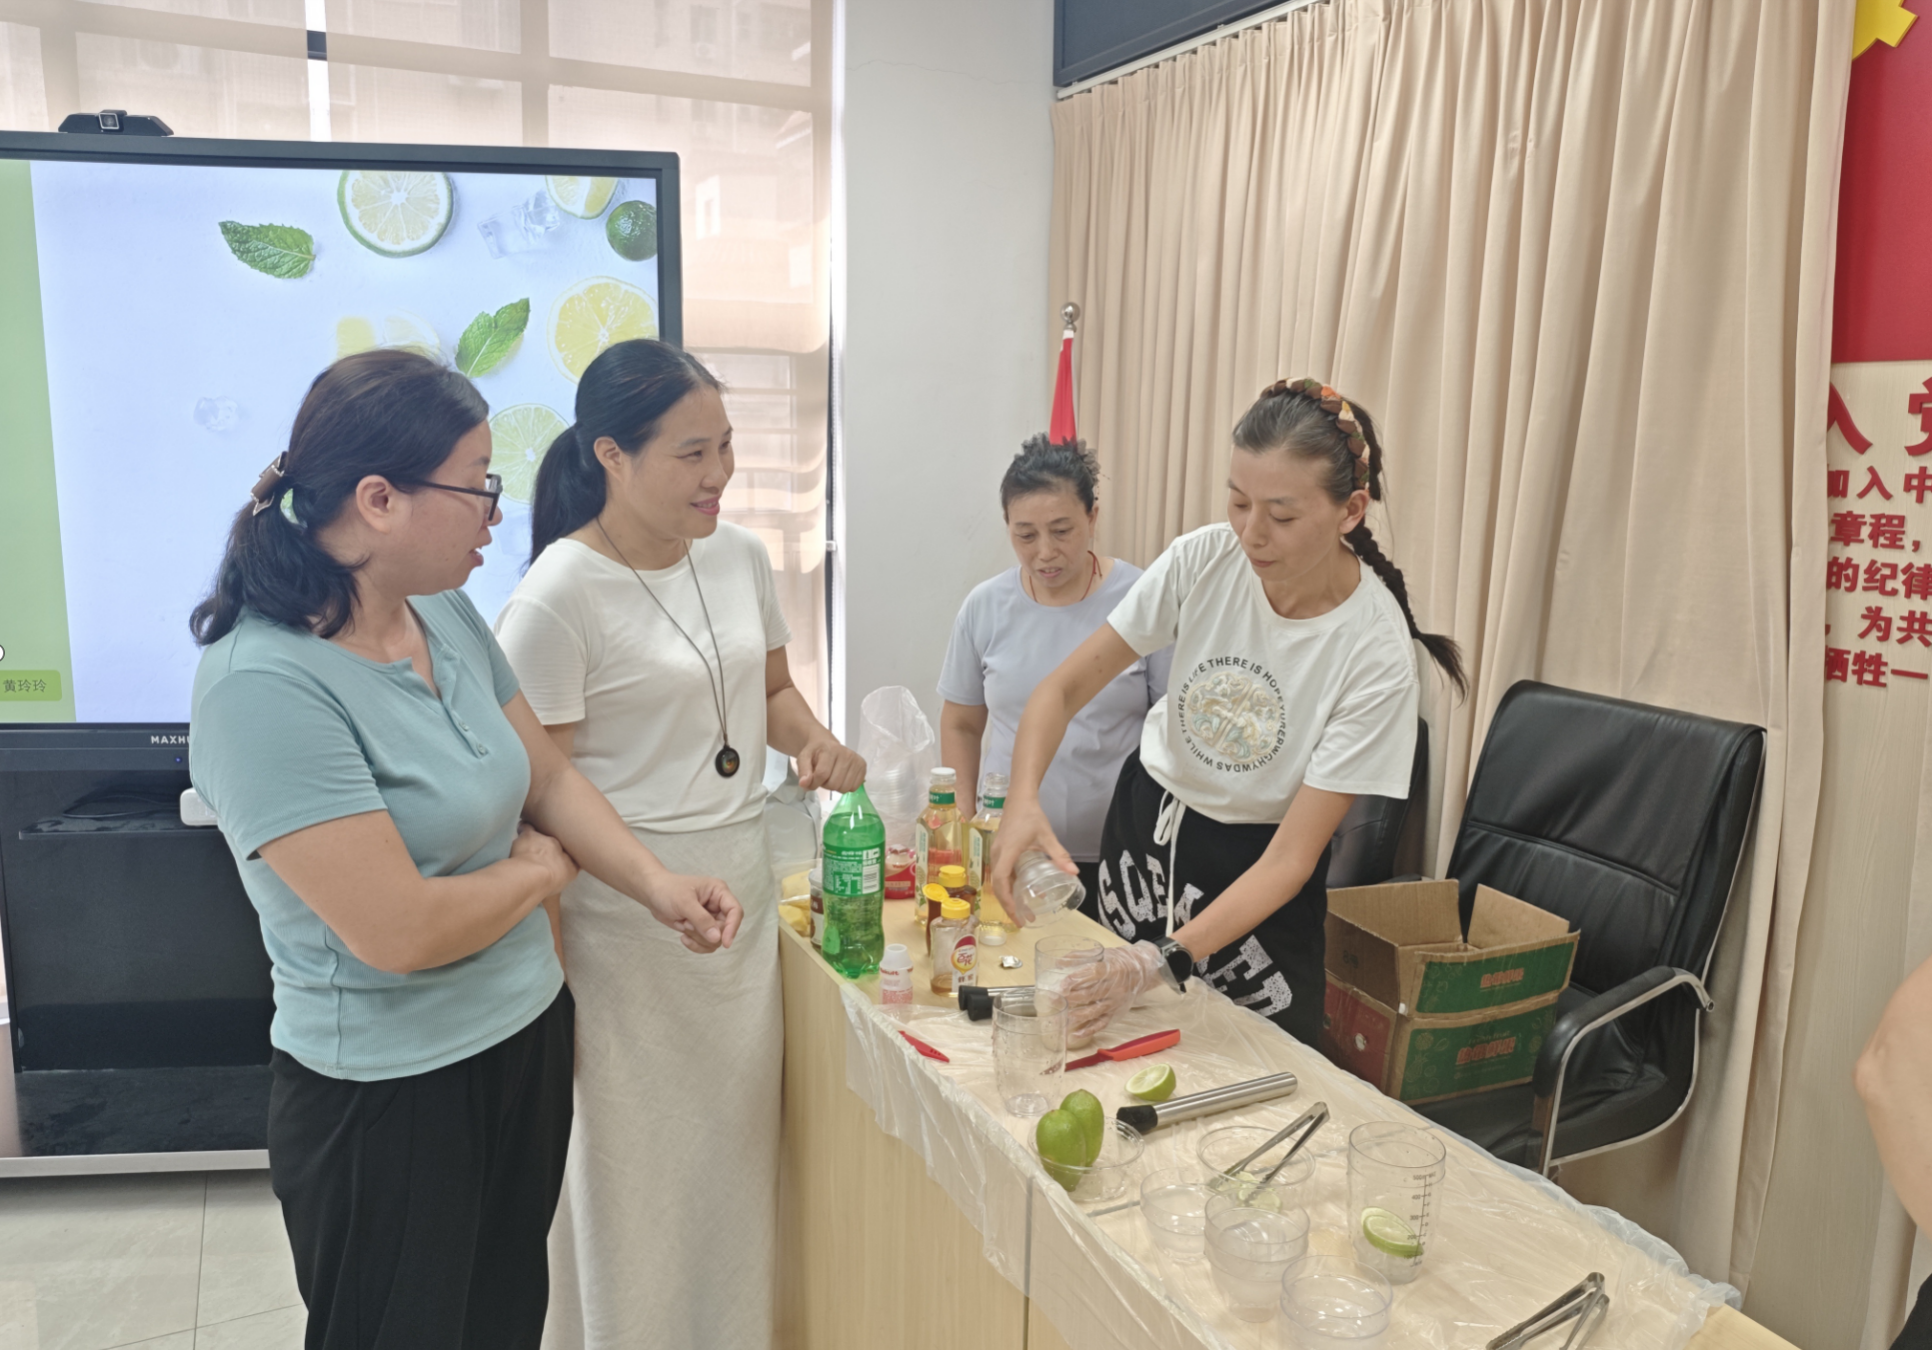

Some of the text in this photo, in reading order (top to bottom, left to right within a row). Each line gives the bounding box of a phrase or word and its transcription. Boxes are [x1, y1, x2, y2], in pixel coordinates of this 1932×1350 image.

[1207, 656, 1248, 669] THERE
[1250, 663, 1262, 675] IS
[3, 678, 47, 693] 黄玲玲
